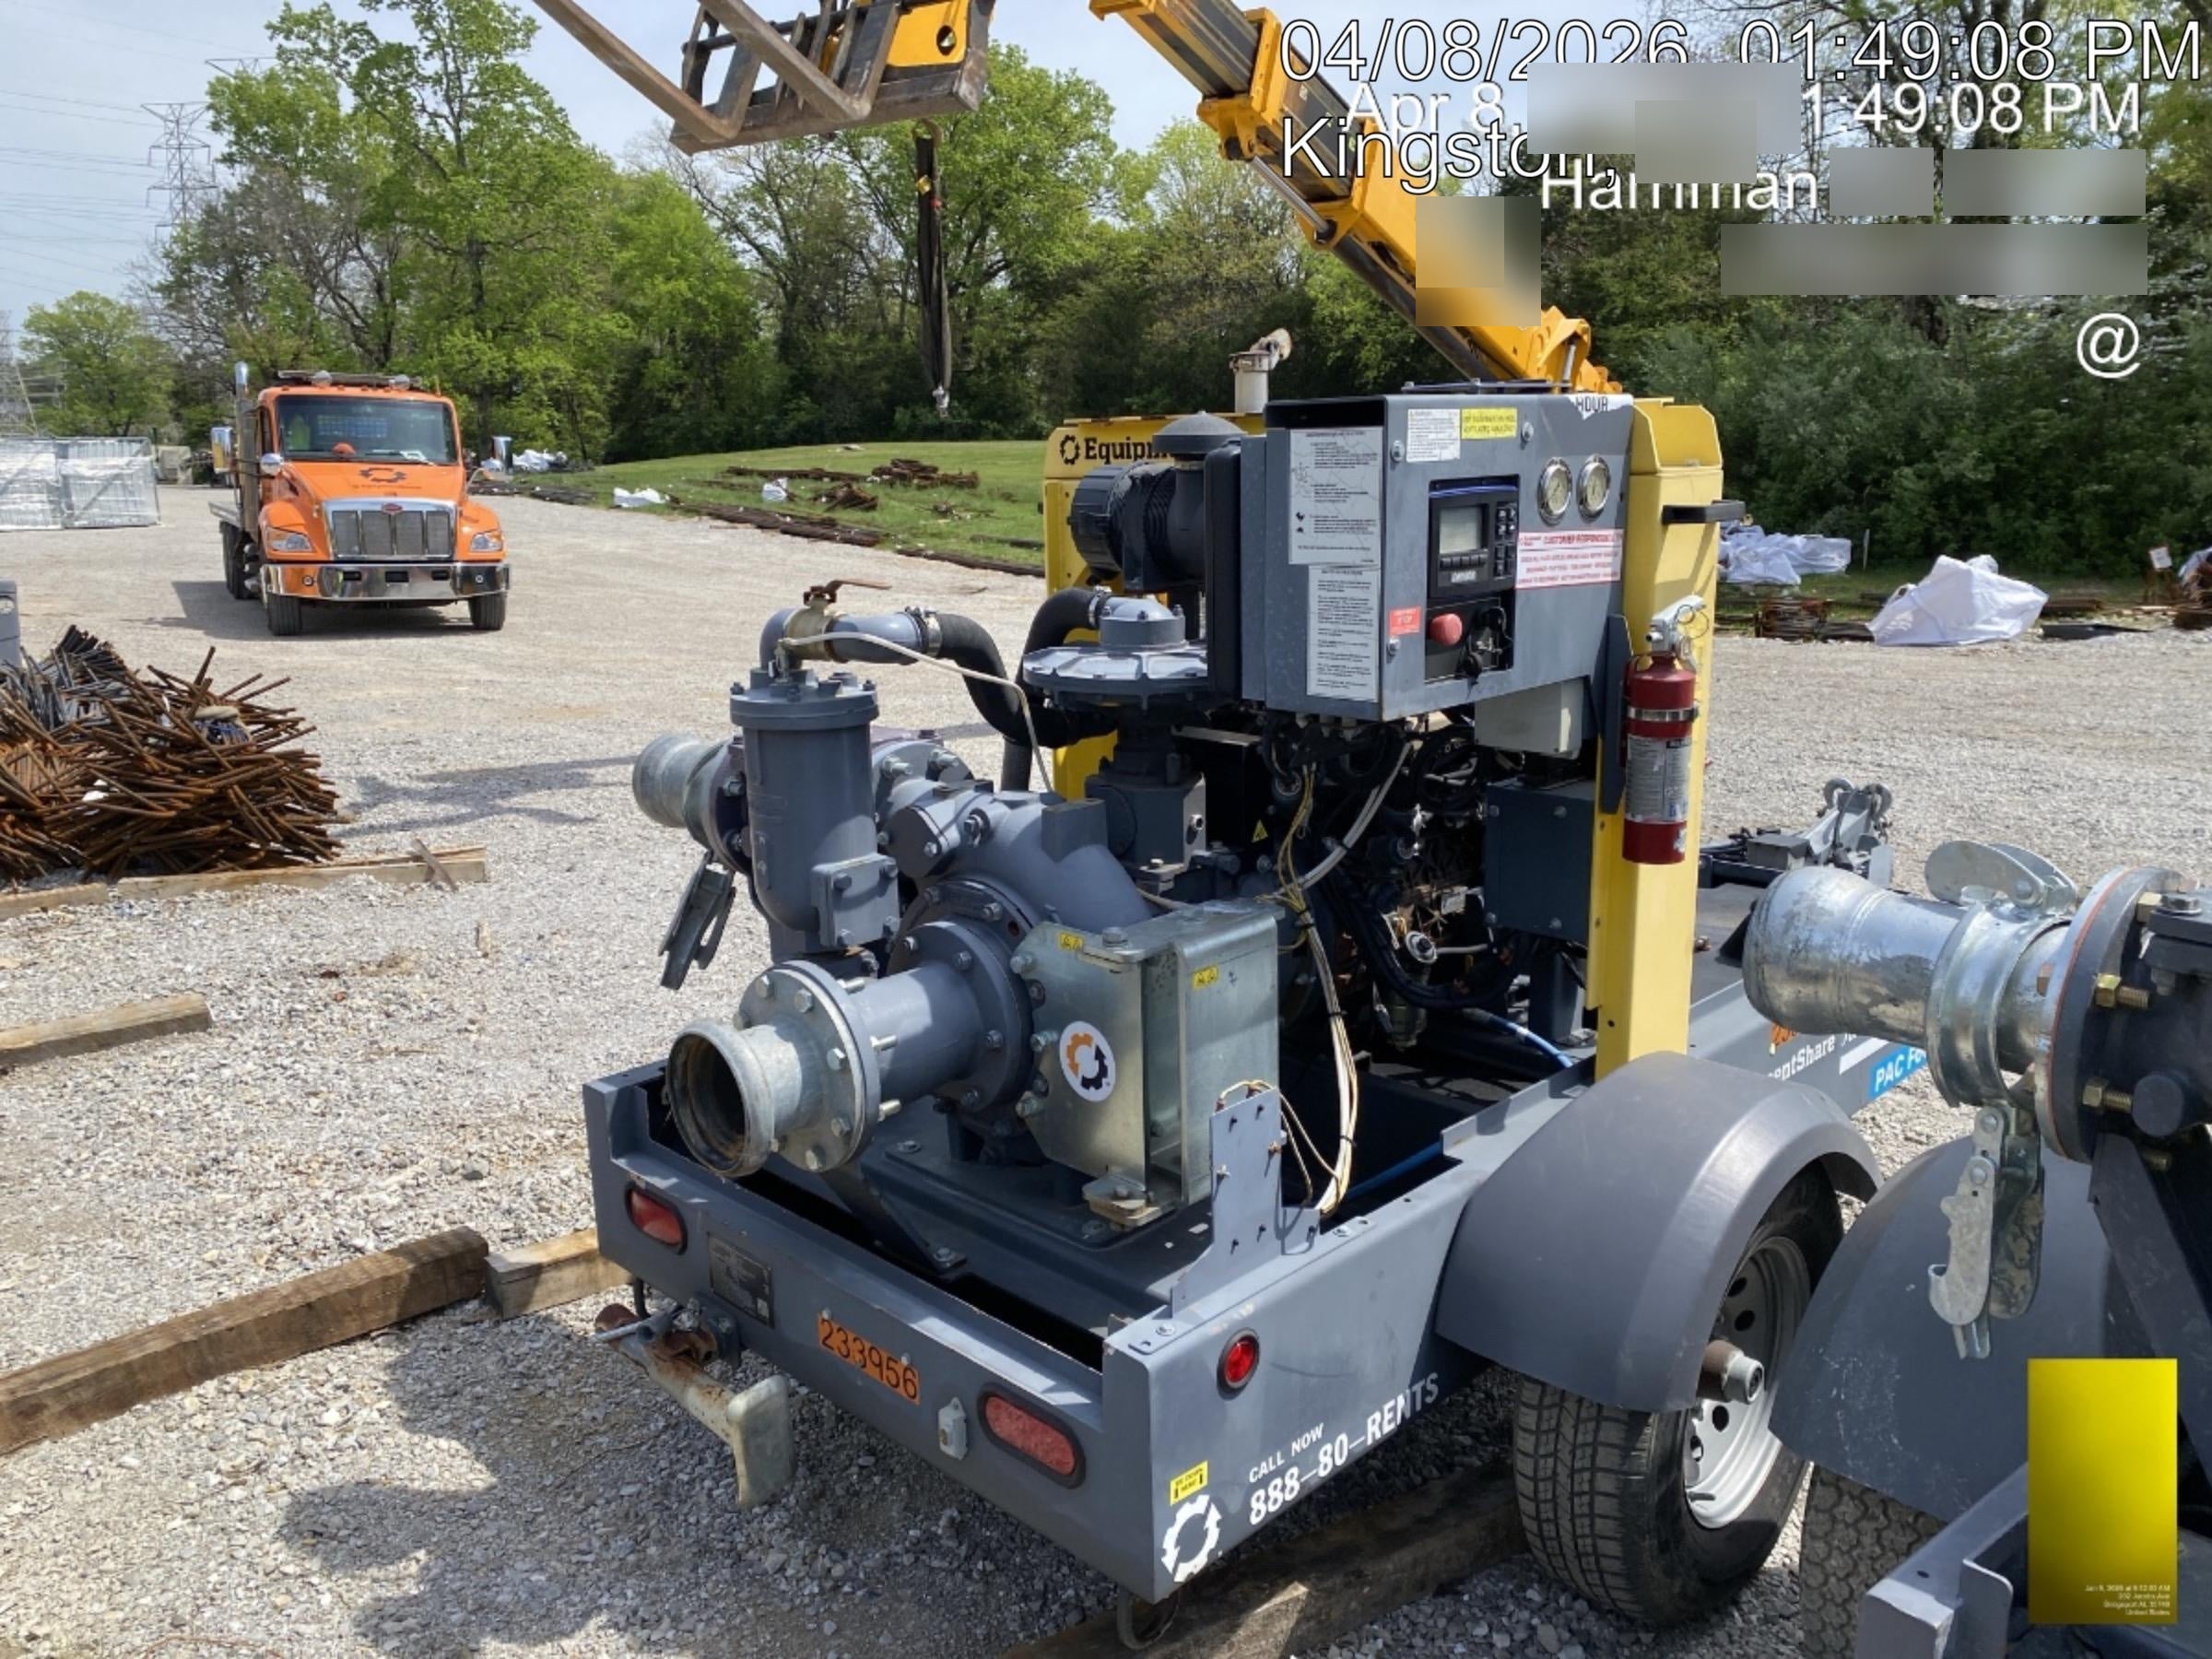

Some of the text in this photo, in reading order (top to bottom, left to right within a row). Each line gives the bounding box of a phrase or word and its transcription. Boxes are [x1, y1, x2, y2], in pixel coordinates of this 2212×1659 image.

[1875, 1053, 1905, 1093] PAC
[819, 1317, 920, 1401] 233956
[1249, 1423, 1324, 1483] CALL NOW
